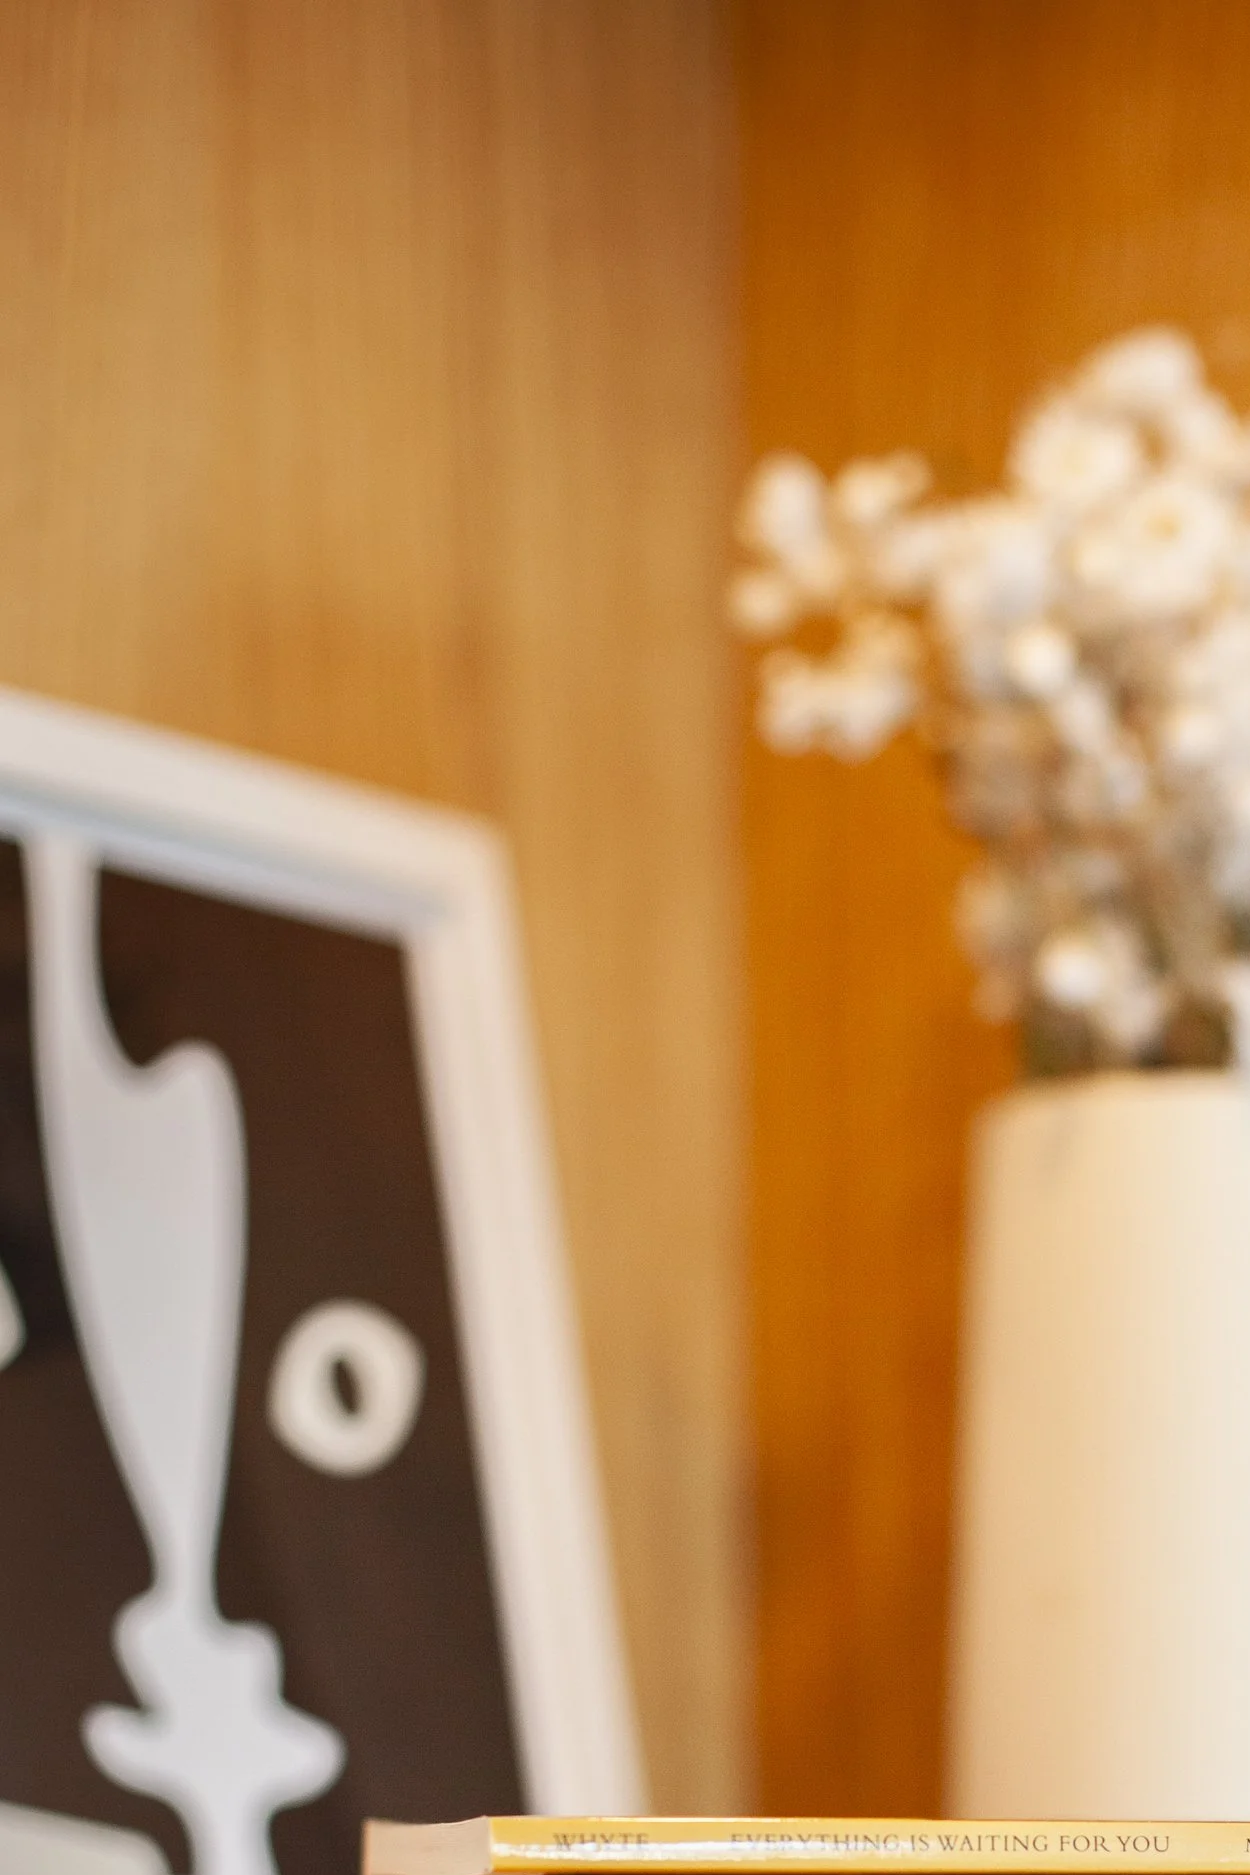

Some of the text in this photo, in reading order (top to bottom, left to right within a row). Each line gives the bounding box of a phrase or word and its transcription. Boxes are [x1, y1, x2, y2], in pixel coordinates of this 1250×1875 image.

[731, 1834, 1171, 1853] EVERYTHING IS WAITING FOR YOU
